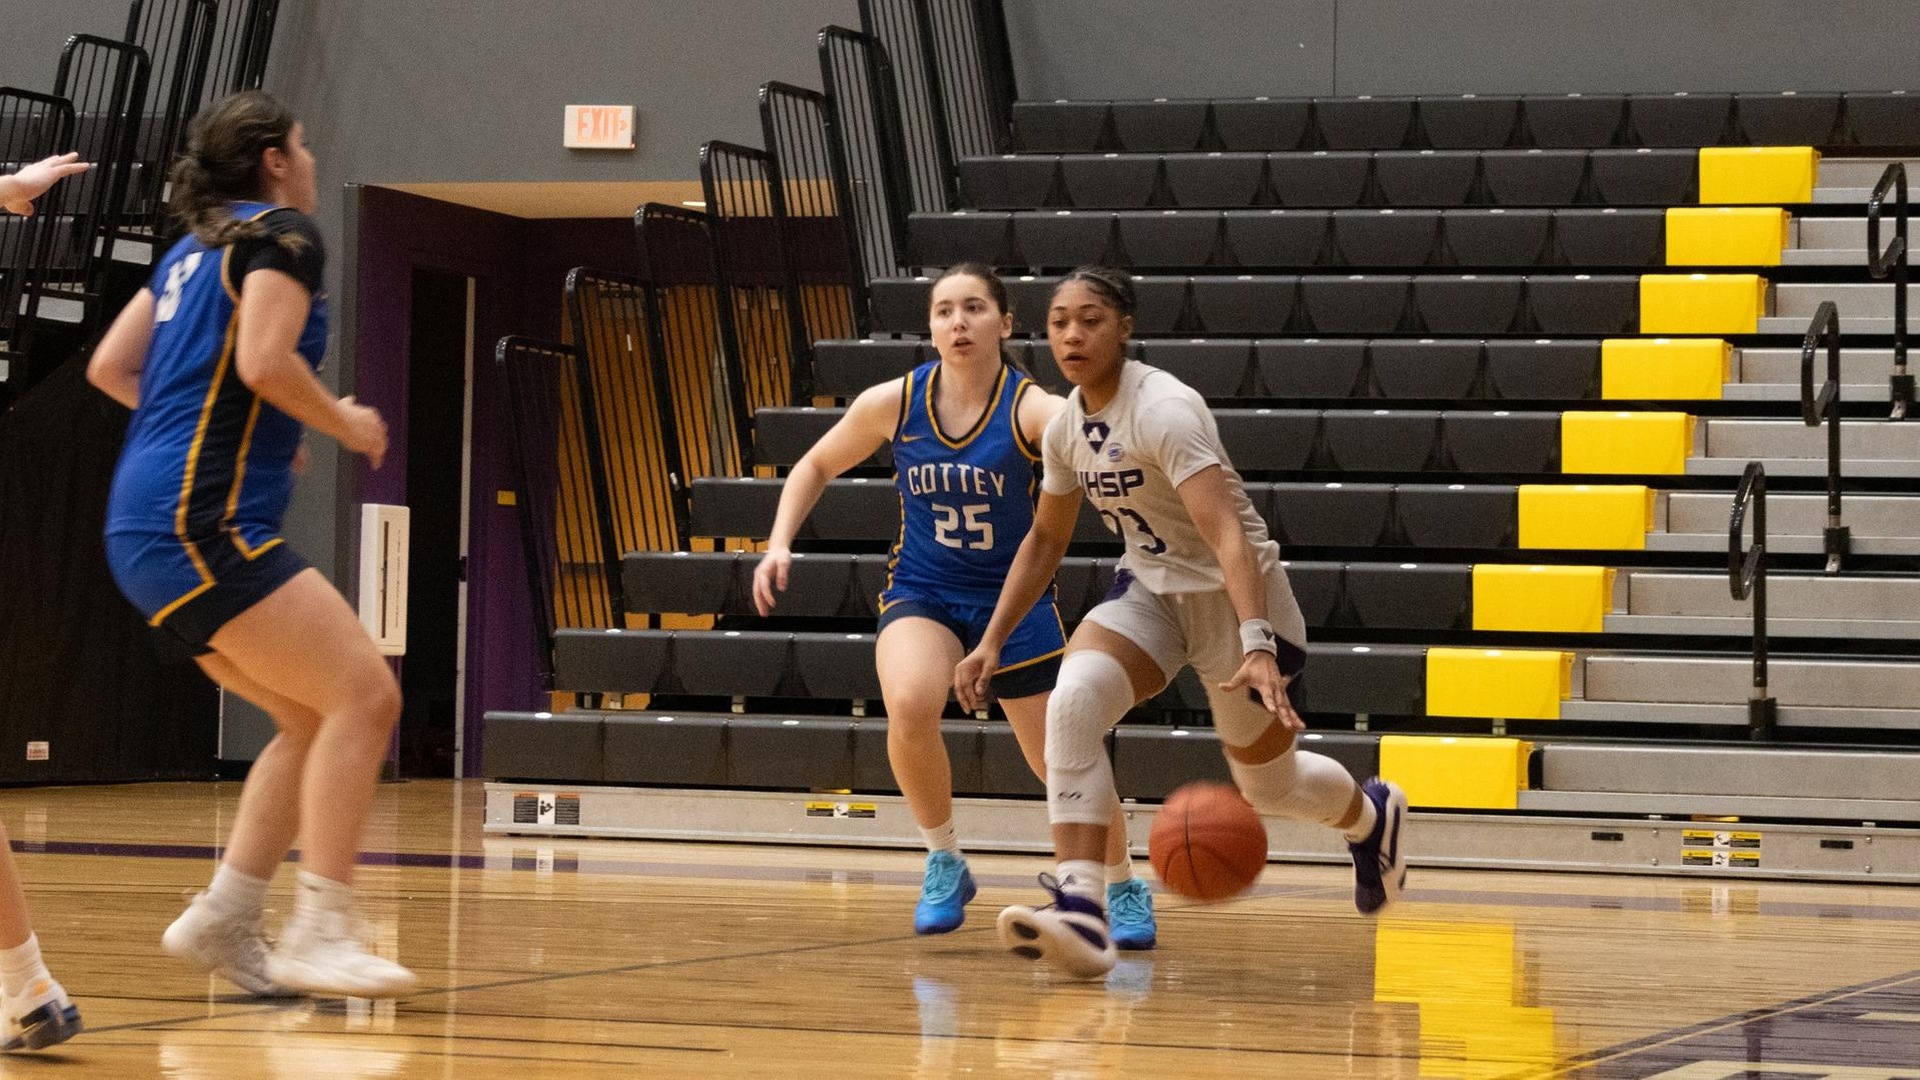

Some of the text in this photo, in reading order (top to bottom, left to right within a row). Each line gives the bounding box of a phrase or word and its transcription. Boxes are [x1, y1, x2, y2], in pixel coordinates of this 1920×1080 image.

[576, 107, 623, 144] EXIT
[908, 462, 1005, 497] COTTEY
[931, 502, 994, 551] 25
